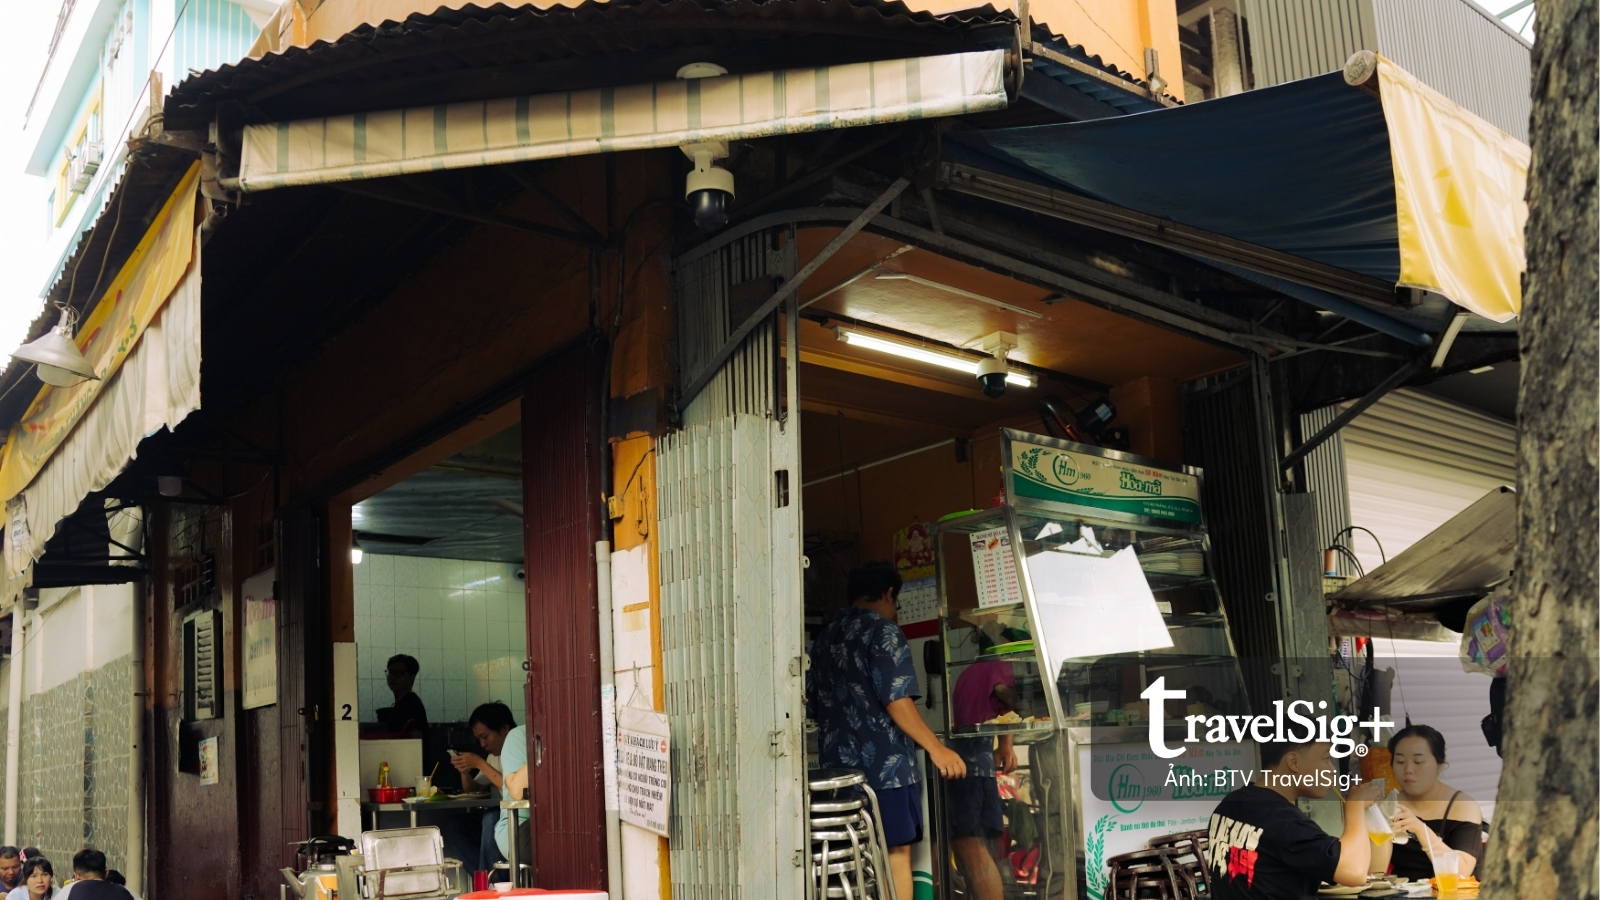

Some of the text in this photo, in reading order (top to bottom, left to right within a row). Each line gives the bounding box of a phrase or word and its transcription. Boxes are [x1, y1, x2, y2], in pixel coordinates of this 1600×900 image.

[1058, 460, 1076, 478] Hm
[342, 704, 352, 720] 2
[1116, 774, 1162, 799] Hm 1960
